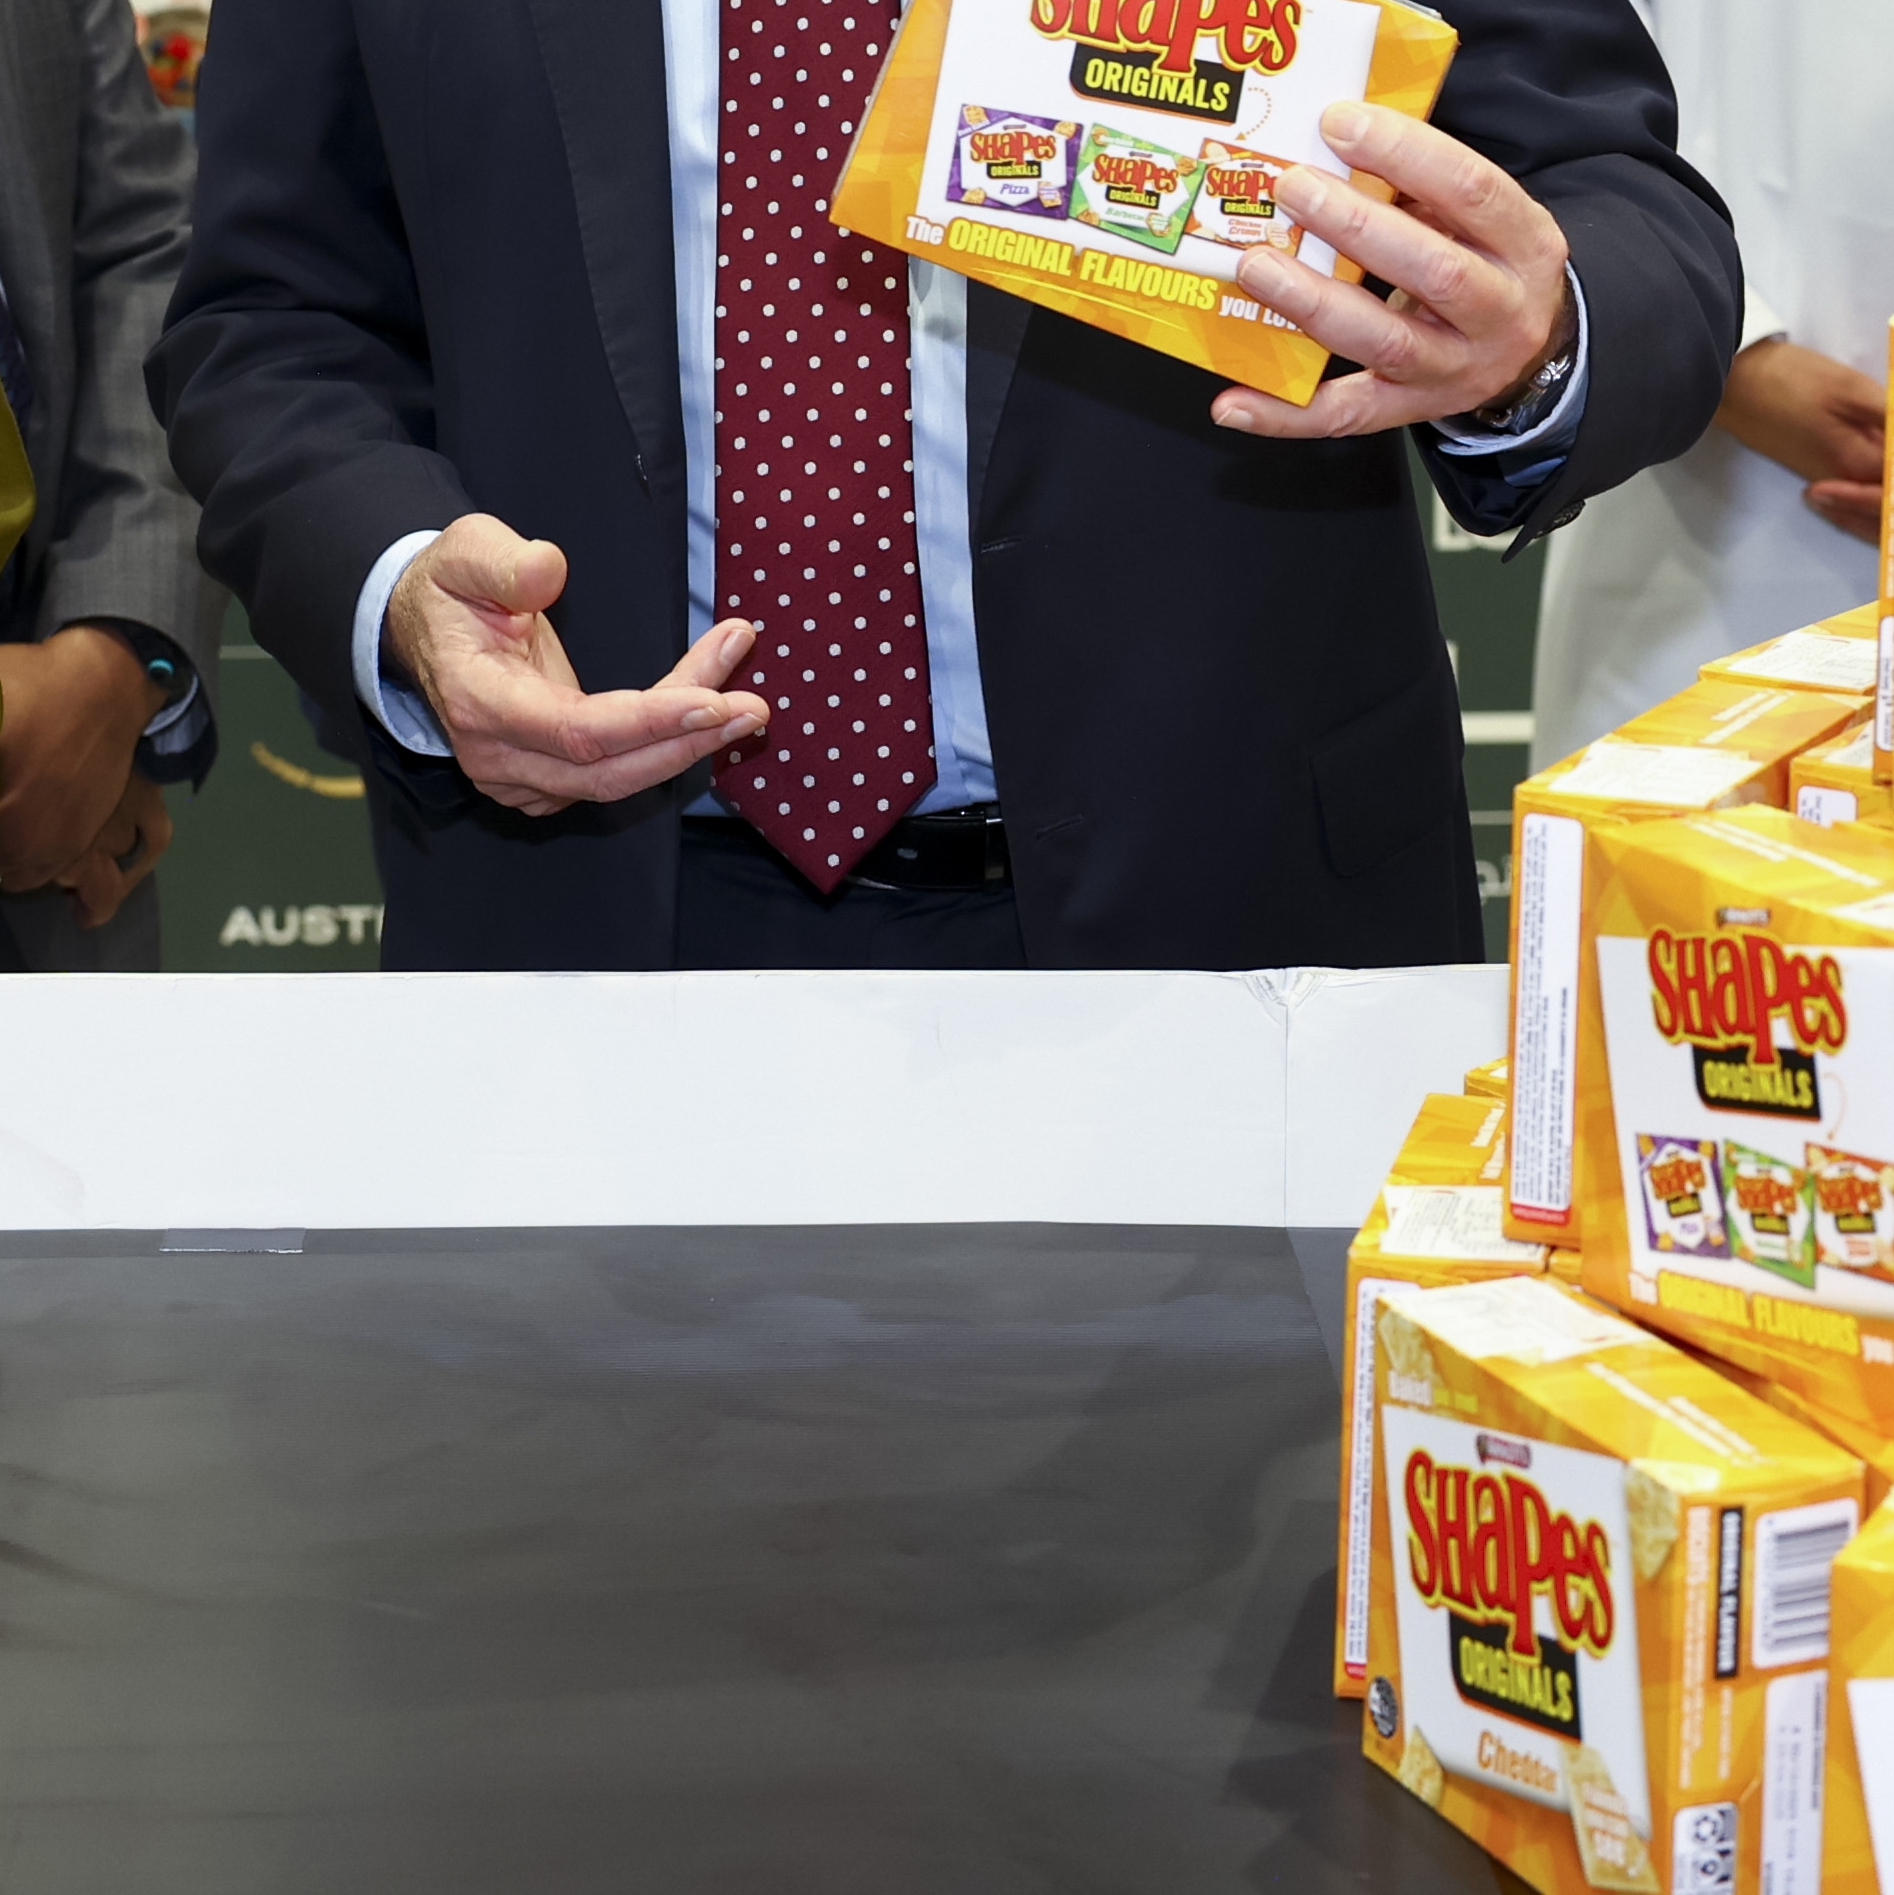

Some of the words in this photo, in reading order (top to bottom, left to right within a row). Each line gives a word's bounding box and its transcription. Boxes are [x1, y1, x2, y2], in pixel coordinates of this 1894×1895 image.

[1083, 61, 1231, 114] ORIGINALS
[905, 214, 943, 246] The
[948, 219, 1072, 277] ORIGINAL
[1079, 248, 1219, 312] FLAVOURS
[1218, 295, 1259, 322] you
[1702, 1057, 1815, 1110] ORIGINALS
[1657, 1269, 1751, 1326] ORIGINAL
[1751, 1293, 1862, 1356] FLAVOURS
[1459, 1636, 1575, 1722] ORIGINALS
[1477, 1729, 1559, 1796] Cheddar
